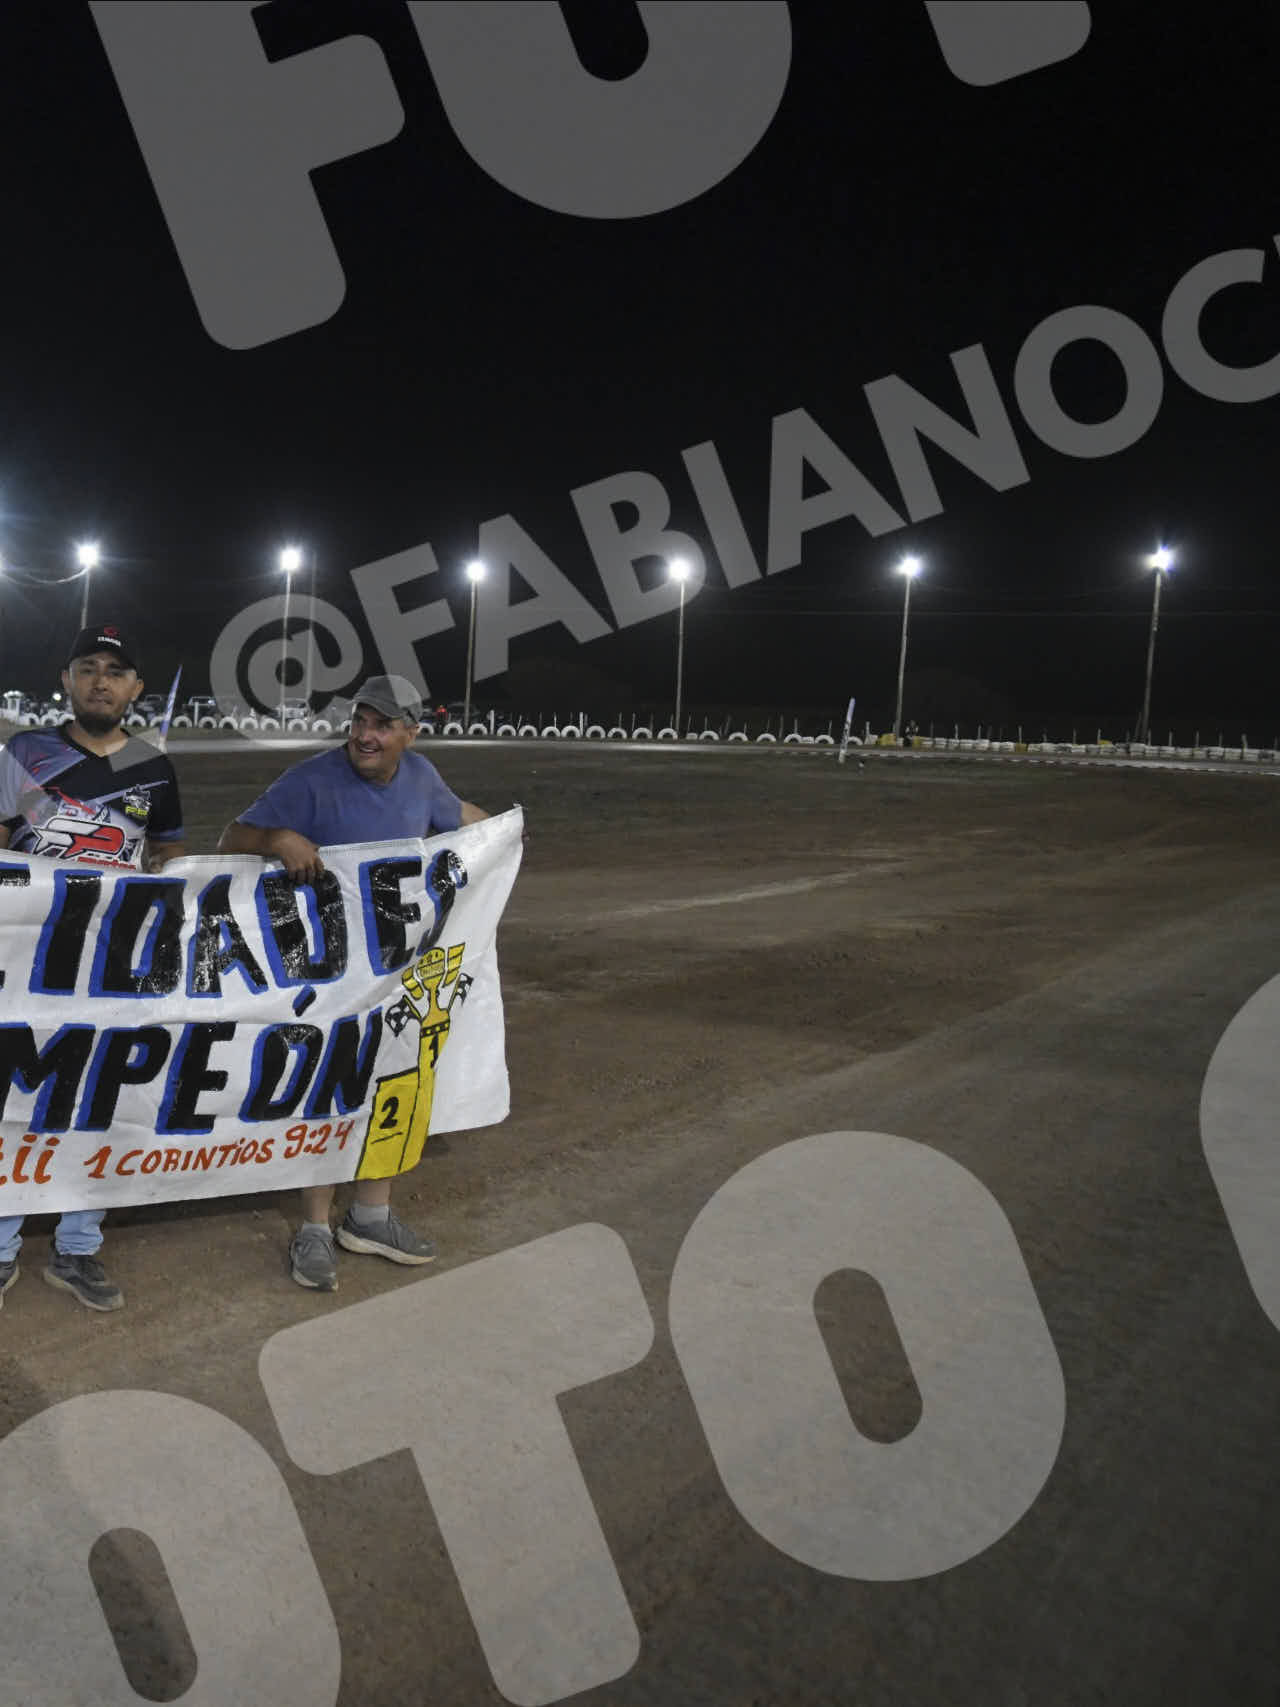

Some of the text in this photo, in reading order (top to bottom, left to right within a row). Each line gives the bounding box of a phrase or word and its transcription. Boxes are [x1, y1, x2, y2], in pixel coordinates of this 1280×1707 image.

[379, 1096, 400, 1130] 2
[83, 1145, 113, 1179] 1
[284, 1119, 356, 1159] 9:24
